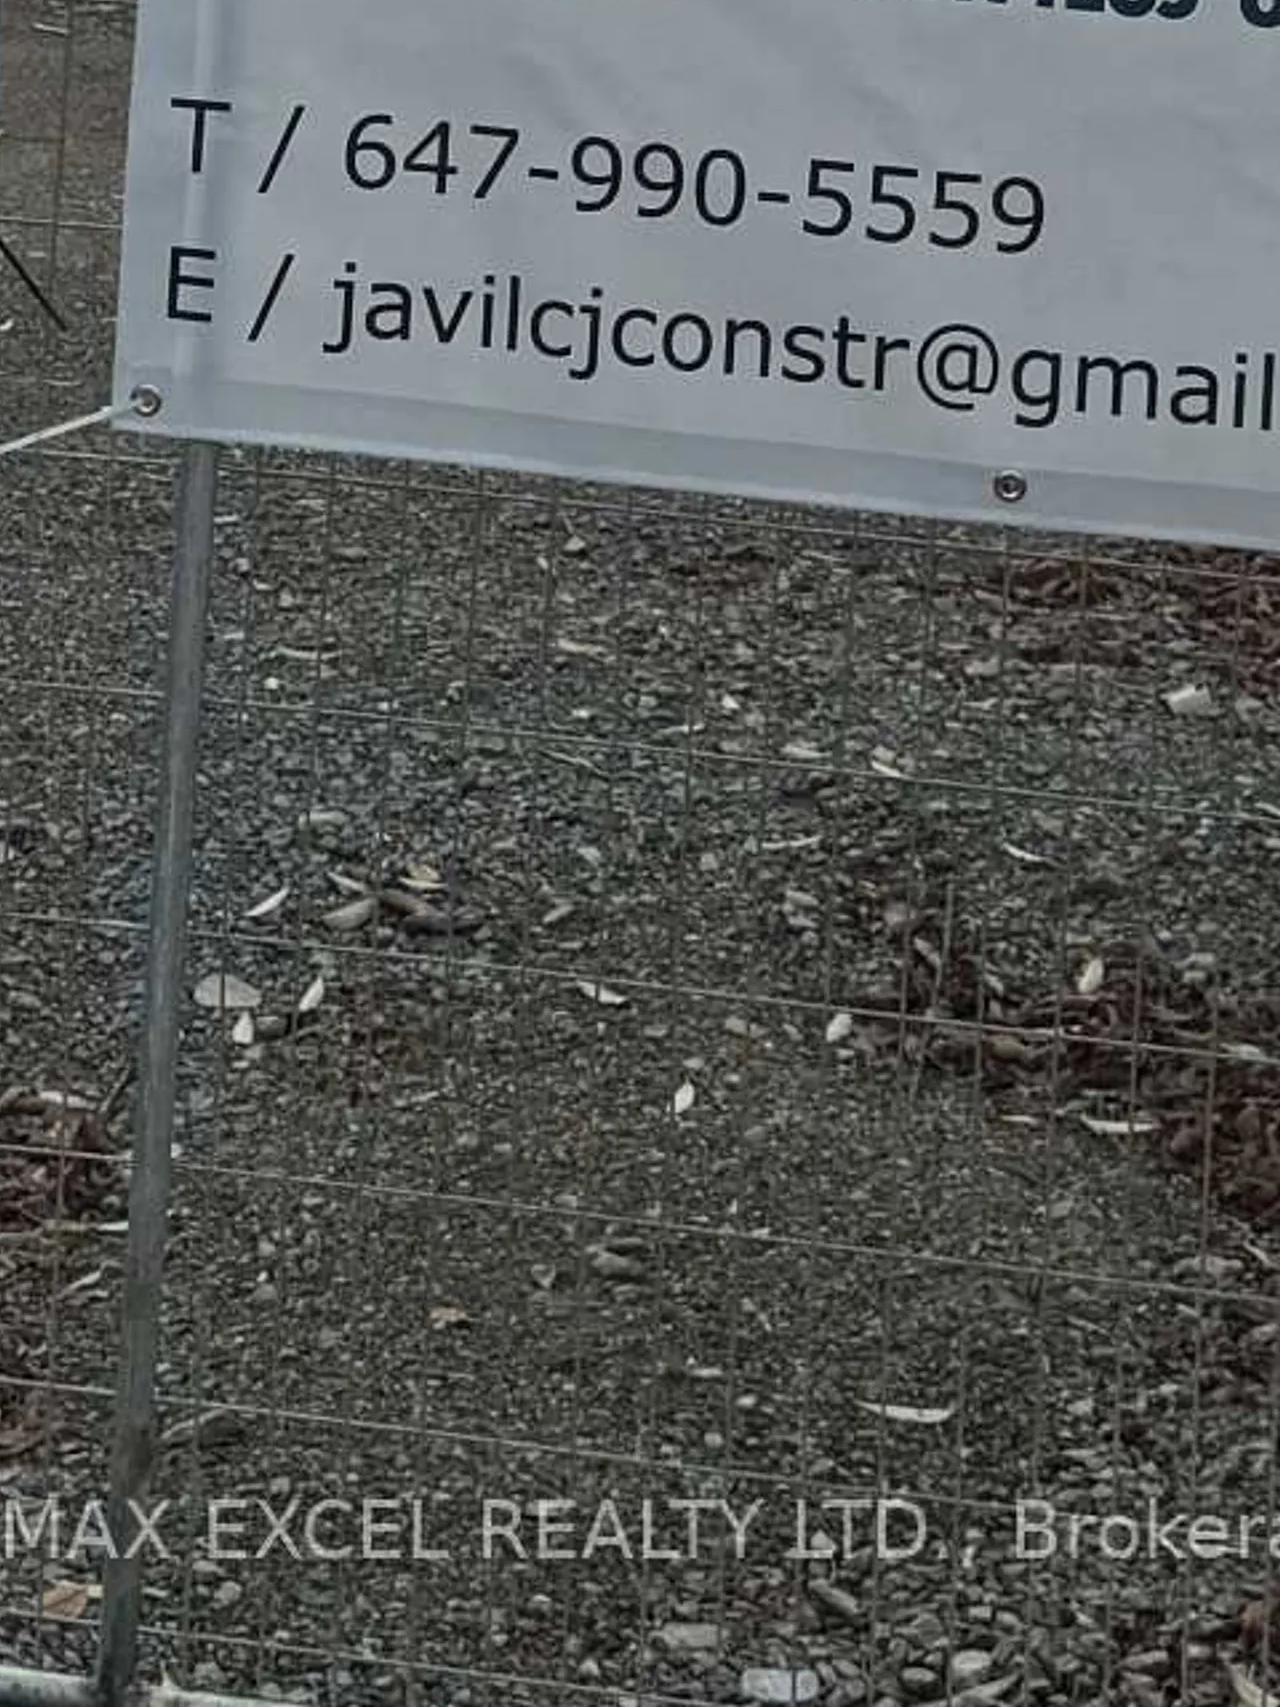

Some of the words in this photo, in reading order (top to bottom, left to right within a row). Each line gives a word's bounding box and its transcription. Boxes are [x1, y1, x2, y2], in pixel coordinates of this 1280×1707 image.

[171, 97, 231, 174] T
[257, 105, 305, 194] /
[345, 114, 1045, 254] 647-990-5559
[167, 246, 216, 324] E
[247, 254, 295, 342] /
